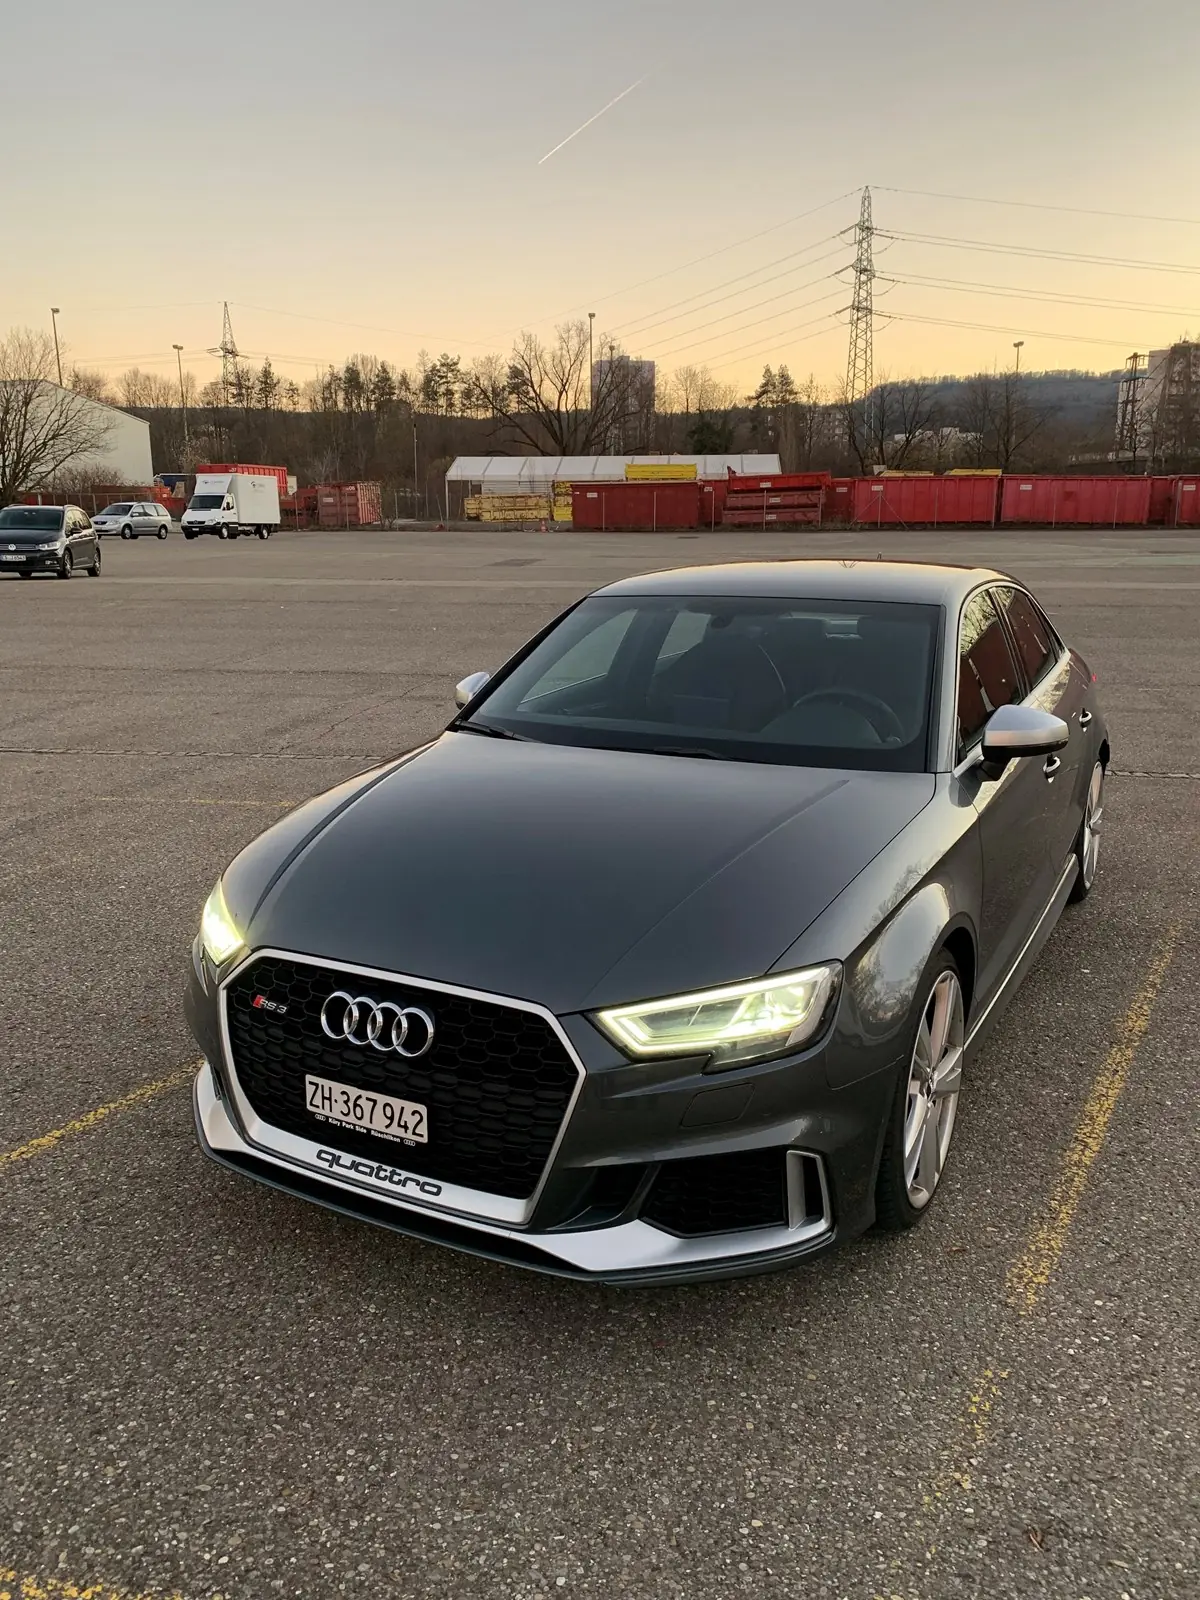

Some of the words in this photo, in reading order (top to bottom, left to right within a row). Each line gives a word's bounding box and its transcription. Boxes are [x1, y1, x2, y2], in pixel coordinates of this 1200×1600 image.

[258, 998, 277, 1010] RS
[276, 1005, 287, 1014] 3
[342, 1121, 354, 1130] Park
[355, 1125, 367, 1134] Side
[382, 1102, 425, 1138] 942
[316, 1149, 442, 1197] quattro
